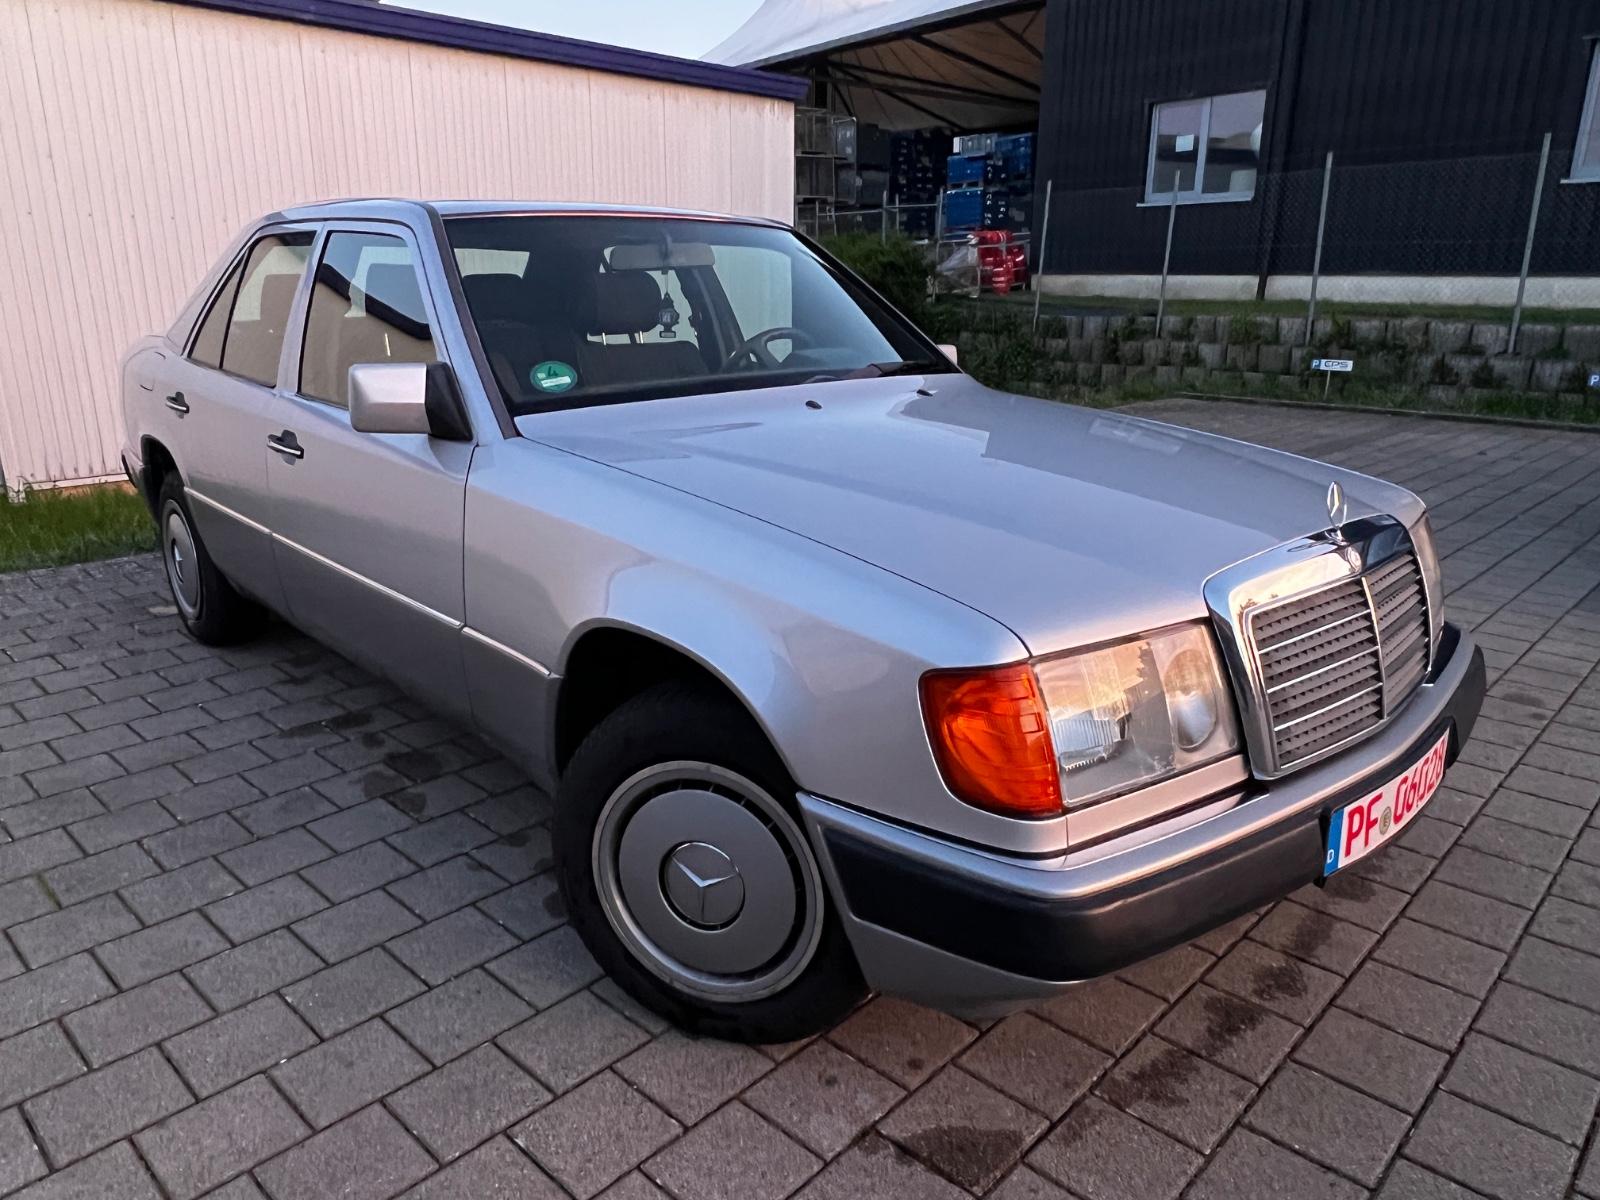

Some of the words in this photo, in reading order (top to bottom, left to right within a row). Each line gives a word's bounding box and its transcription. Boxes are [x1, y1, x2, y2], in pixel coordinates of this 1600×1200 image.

[1312, 359, 1319, 368] P
[1590, 374, 1599, 386] P
[1344, 791, 1383, 857] PF
[1327, 849, 1335, 863] D
